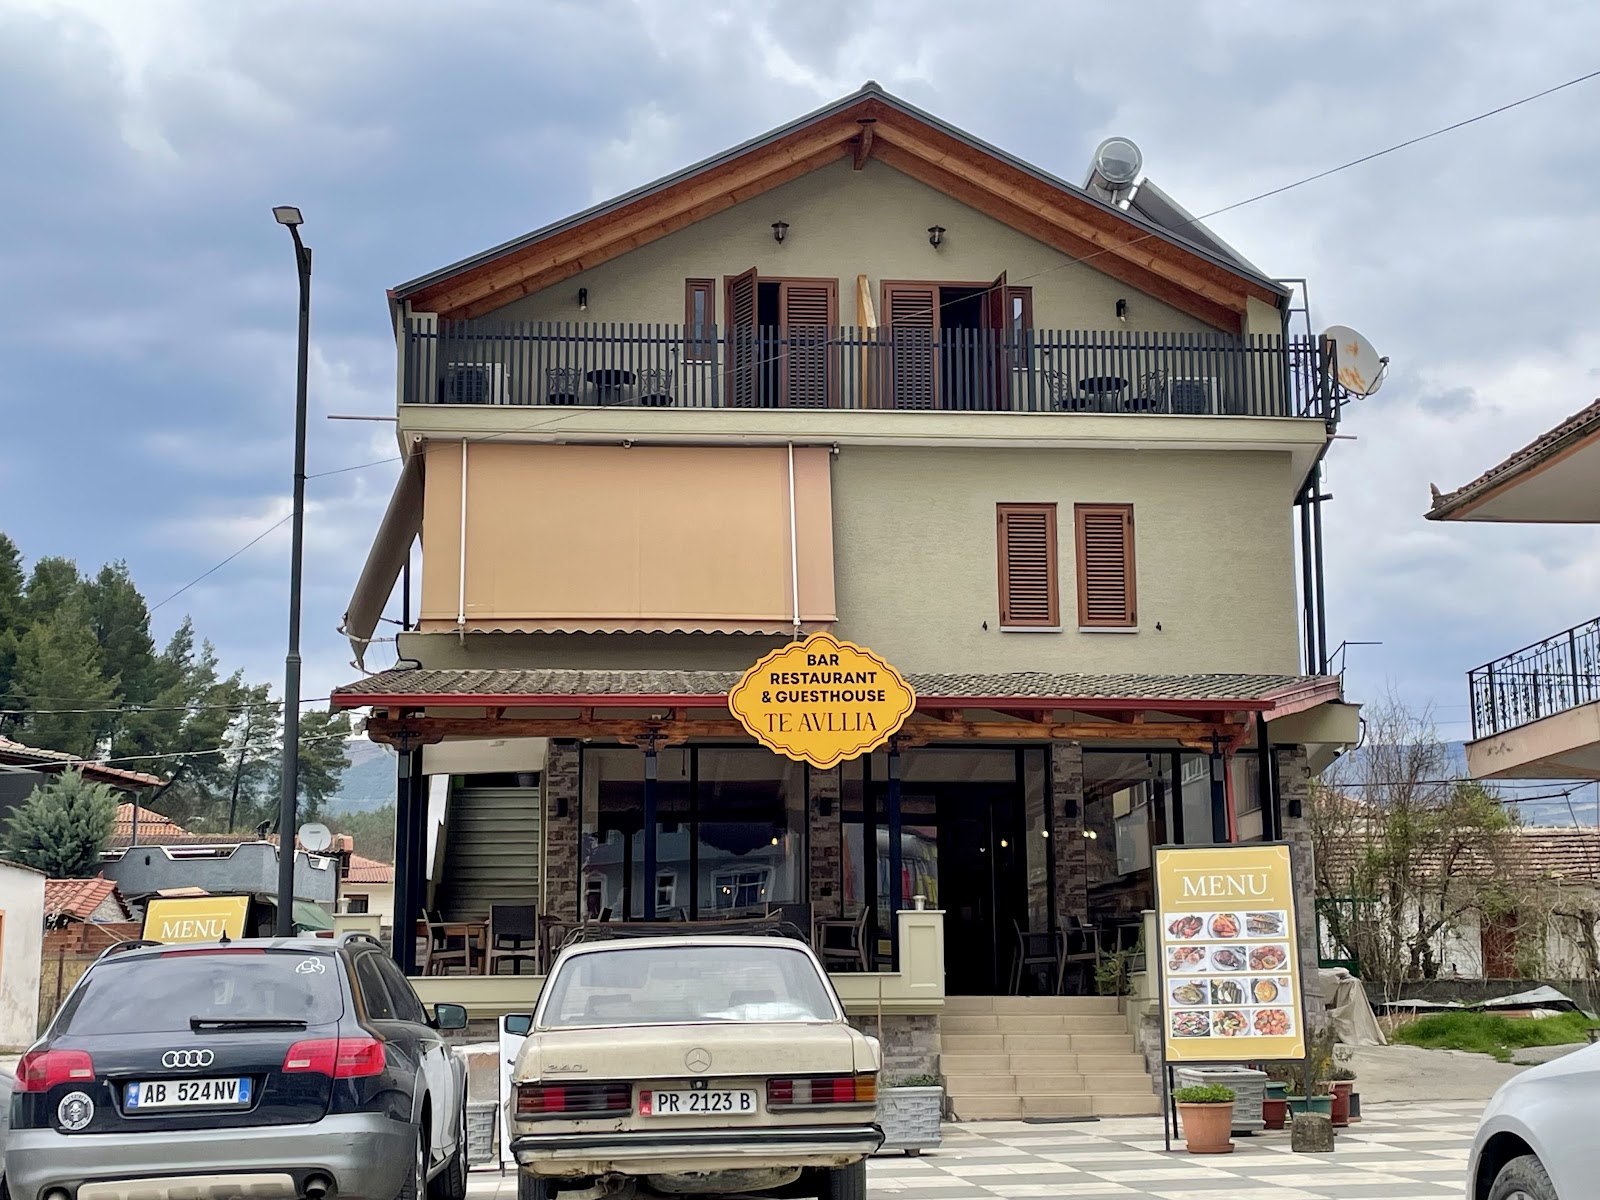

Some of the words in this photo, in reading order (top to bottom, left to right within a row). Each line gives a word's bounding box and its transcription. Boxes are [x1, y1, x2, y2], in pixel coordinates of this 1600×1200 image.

[807, 654, 839, 666] BAR
[770, 672, 877, 684] RESTAURANT
[761, 691, 771, 702] &
[775, 690, 885, 702] GUESTHOUSE
[764, 712, 793, 733] TE
[1183, 874, 1267, 896] MENU
[161, 919, 228, 939] MENU
[144, 1084, 166, 1103] AB
[658, 1093, 680, 1112] PR
[689, 1092, 733, 1111] 2123
[740, 1092, 751, 1111] B
